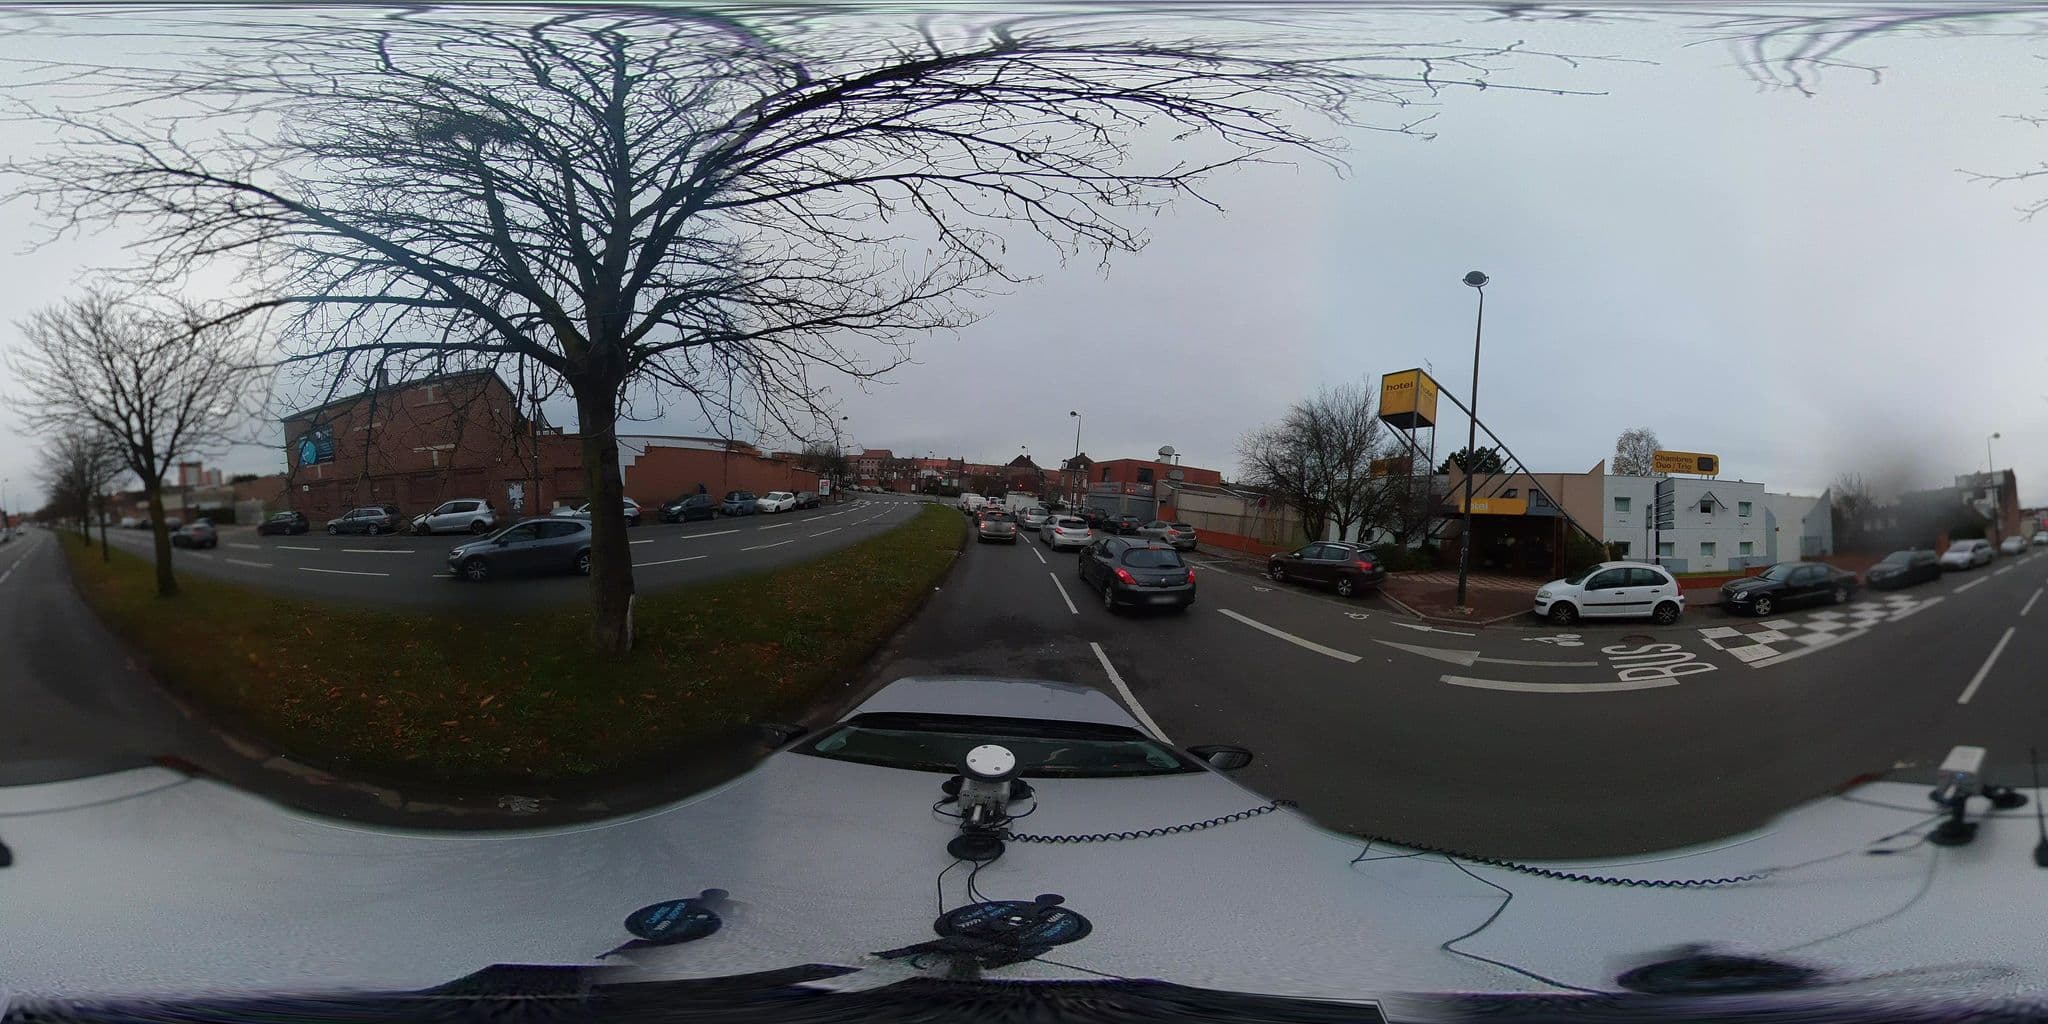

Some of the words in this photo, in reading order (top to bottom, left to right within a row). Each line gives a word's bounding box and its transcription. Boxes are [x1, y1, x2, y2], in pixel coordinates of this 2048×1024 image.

[1386, 381, 1414, 391] hotel
[1654, 454, 1693, 464] Chambres
[1601, 643, 1718, 682] BUS
